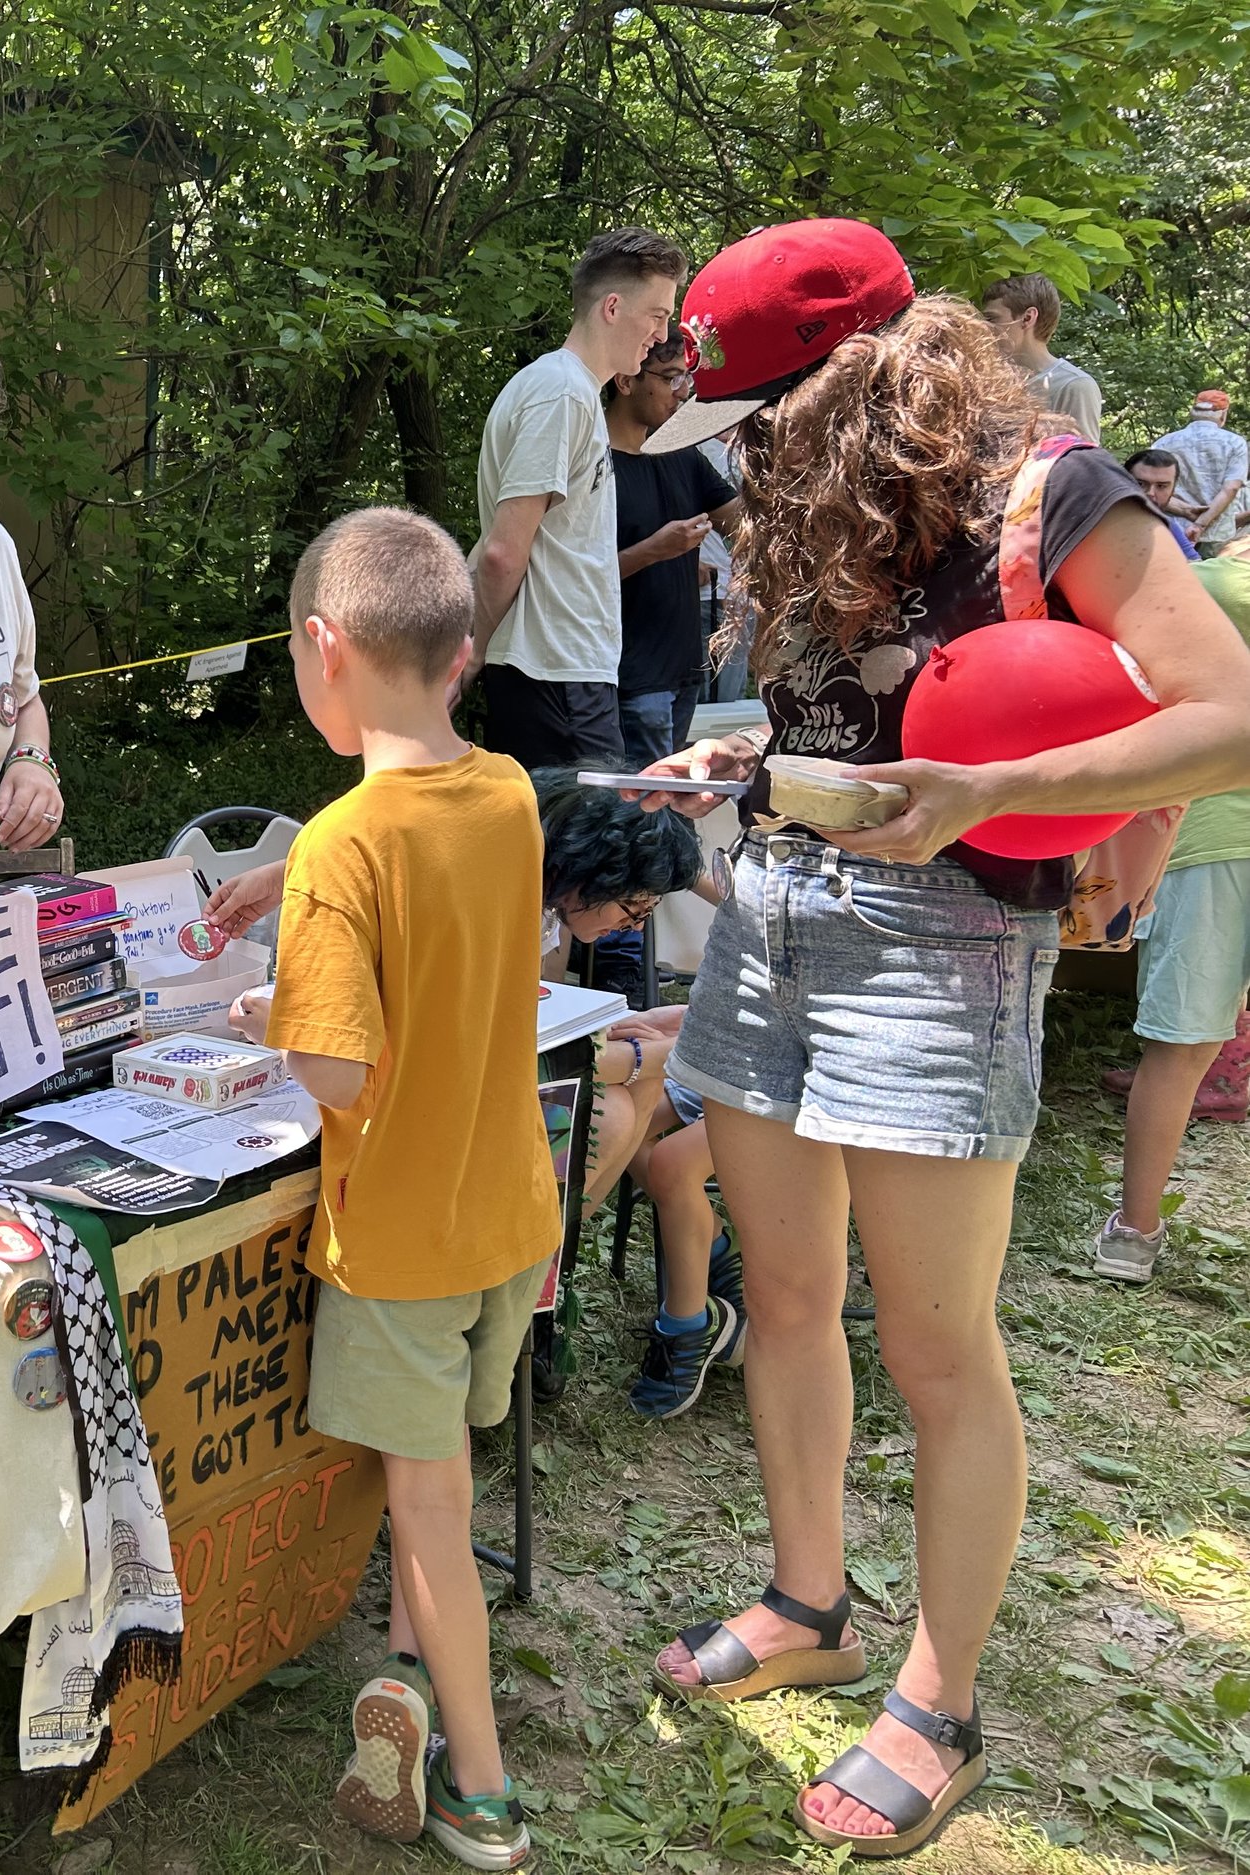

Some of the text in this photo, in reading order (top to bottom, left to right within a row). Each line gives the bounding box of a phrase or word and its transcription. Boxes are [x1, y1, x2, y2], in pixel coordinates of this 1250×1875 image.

[796, 701, 844, 726] LOVE
[787, 723, 862, 751] BLOOMS
[123, 893, 175, 921] Buttons!
[42, 1067, 94, 1094] As Old as Time
[133, 1070, 177, 1092] slamwich
[232, 1071, 270, 1098] slamwich
[17, 1133, 48, 1145] UC
[7, 1137, 94, 1170] GENOCIDE.
[183, 1339, 290, 1426] THESE
[191, 1412, 256, 1485] GOT
[102, 1567, 359, 1784] STUDENTS
